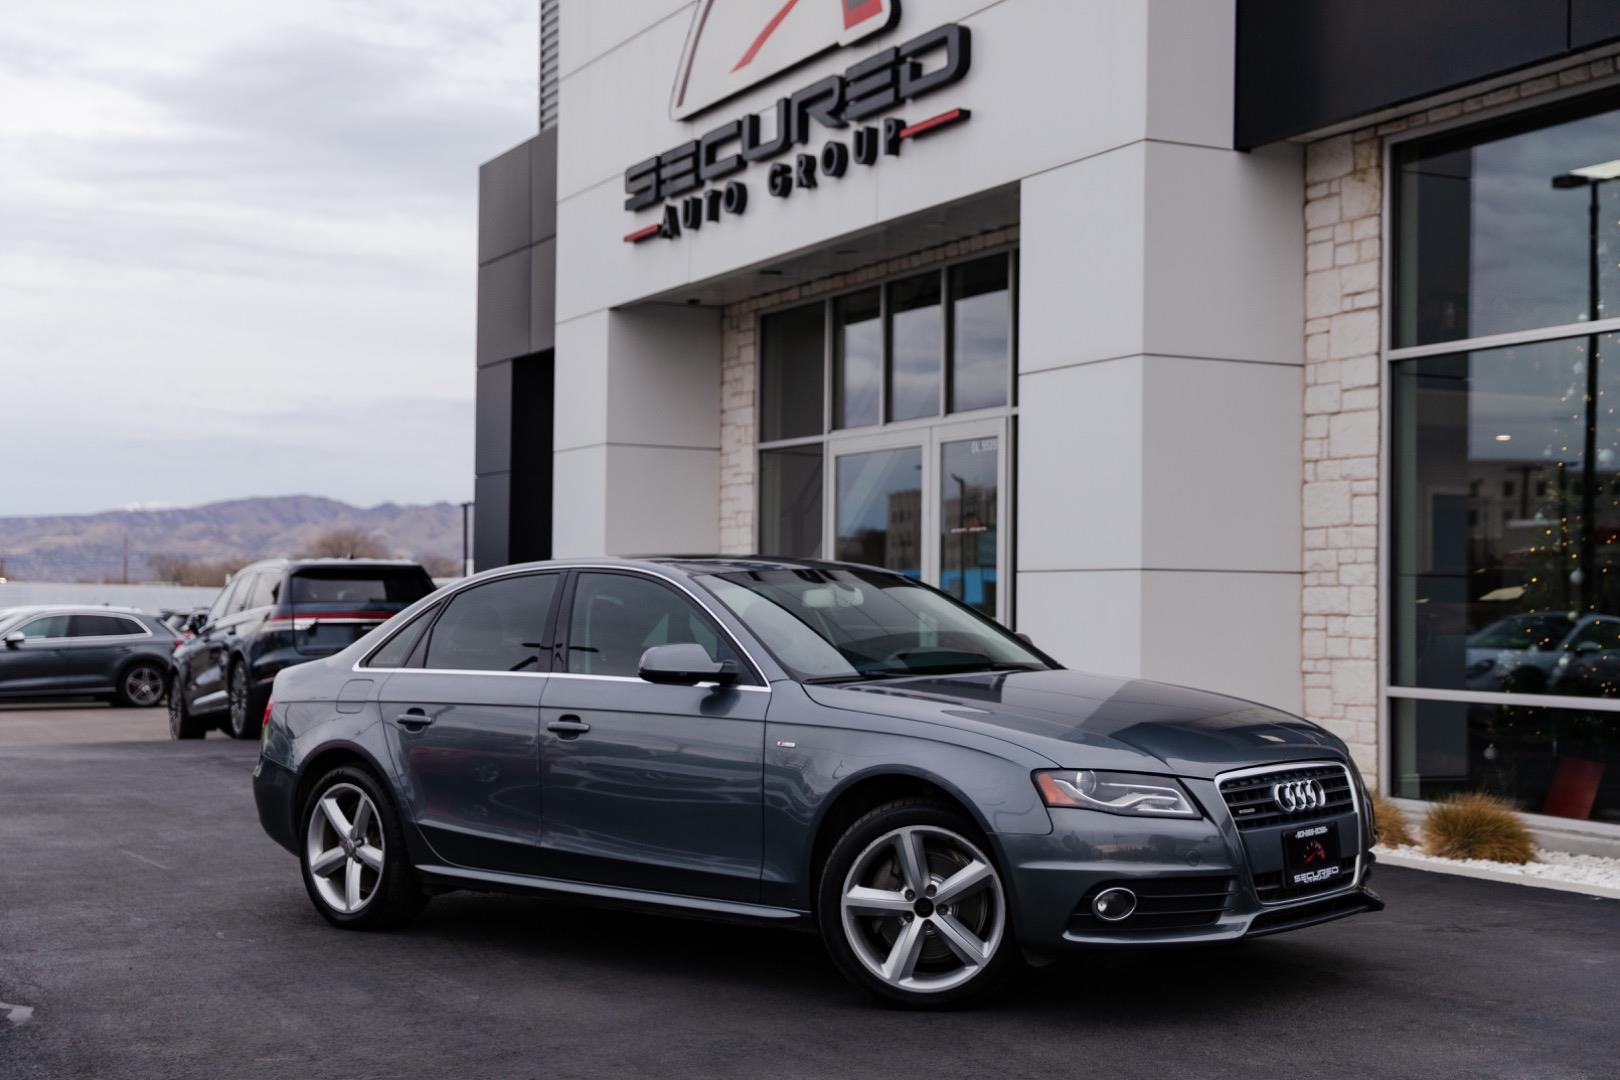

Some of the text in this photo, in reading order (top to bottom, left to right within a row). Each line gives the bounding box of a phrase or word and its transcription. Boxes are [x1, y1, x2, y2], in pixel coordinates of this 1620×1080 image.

[625, 23, 971, 211] SECURED
[659, 118, 906, 240] AUTO GROUP
[1293, 865, 1339, 884] SECURED
